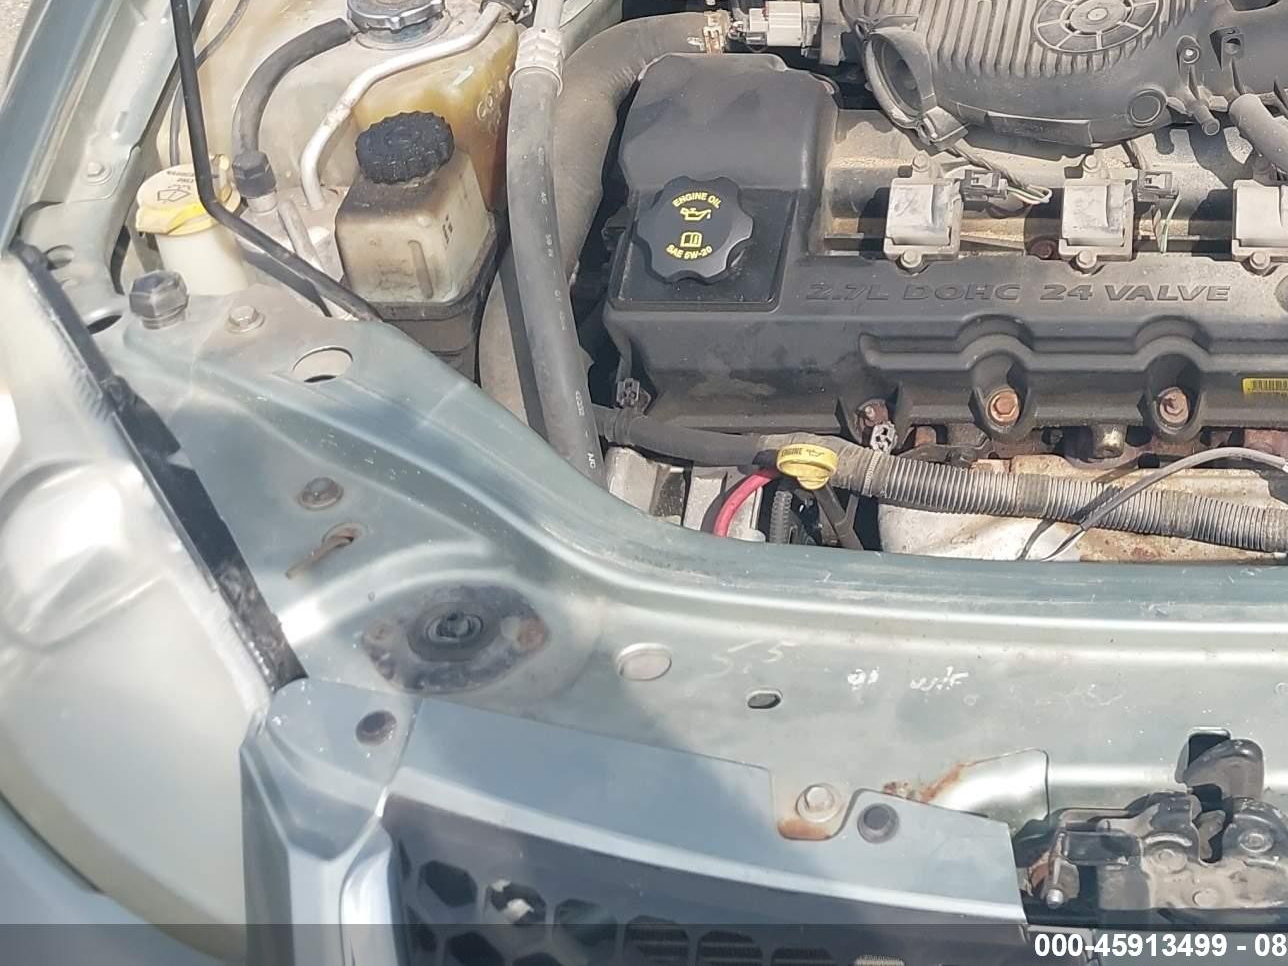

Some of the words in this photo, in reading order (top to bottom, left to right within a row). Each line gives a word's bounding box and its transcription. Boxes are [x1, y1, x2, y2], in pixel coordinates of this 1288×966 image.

[672, 192, 708, 208] ENGINE
[708, 195, 722, 209] OIL
[666, 244, 684, 259] SAE
[684, 245, 713, 260] 5W-20
[805, 282, 889, 302] 2.7L
[903, 283, 1020, 301] DOHC
[1039, 284, 1095, 301] 24
[1104, 284, 1232, 302] VALVE
